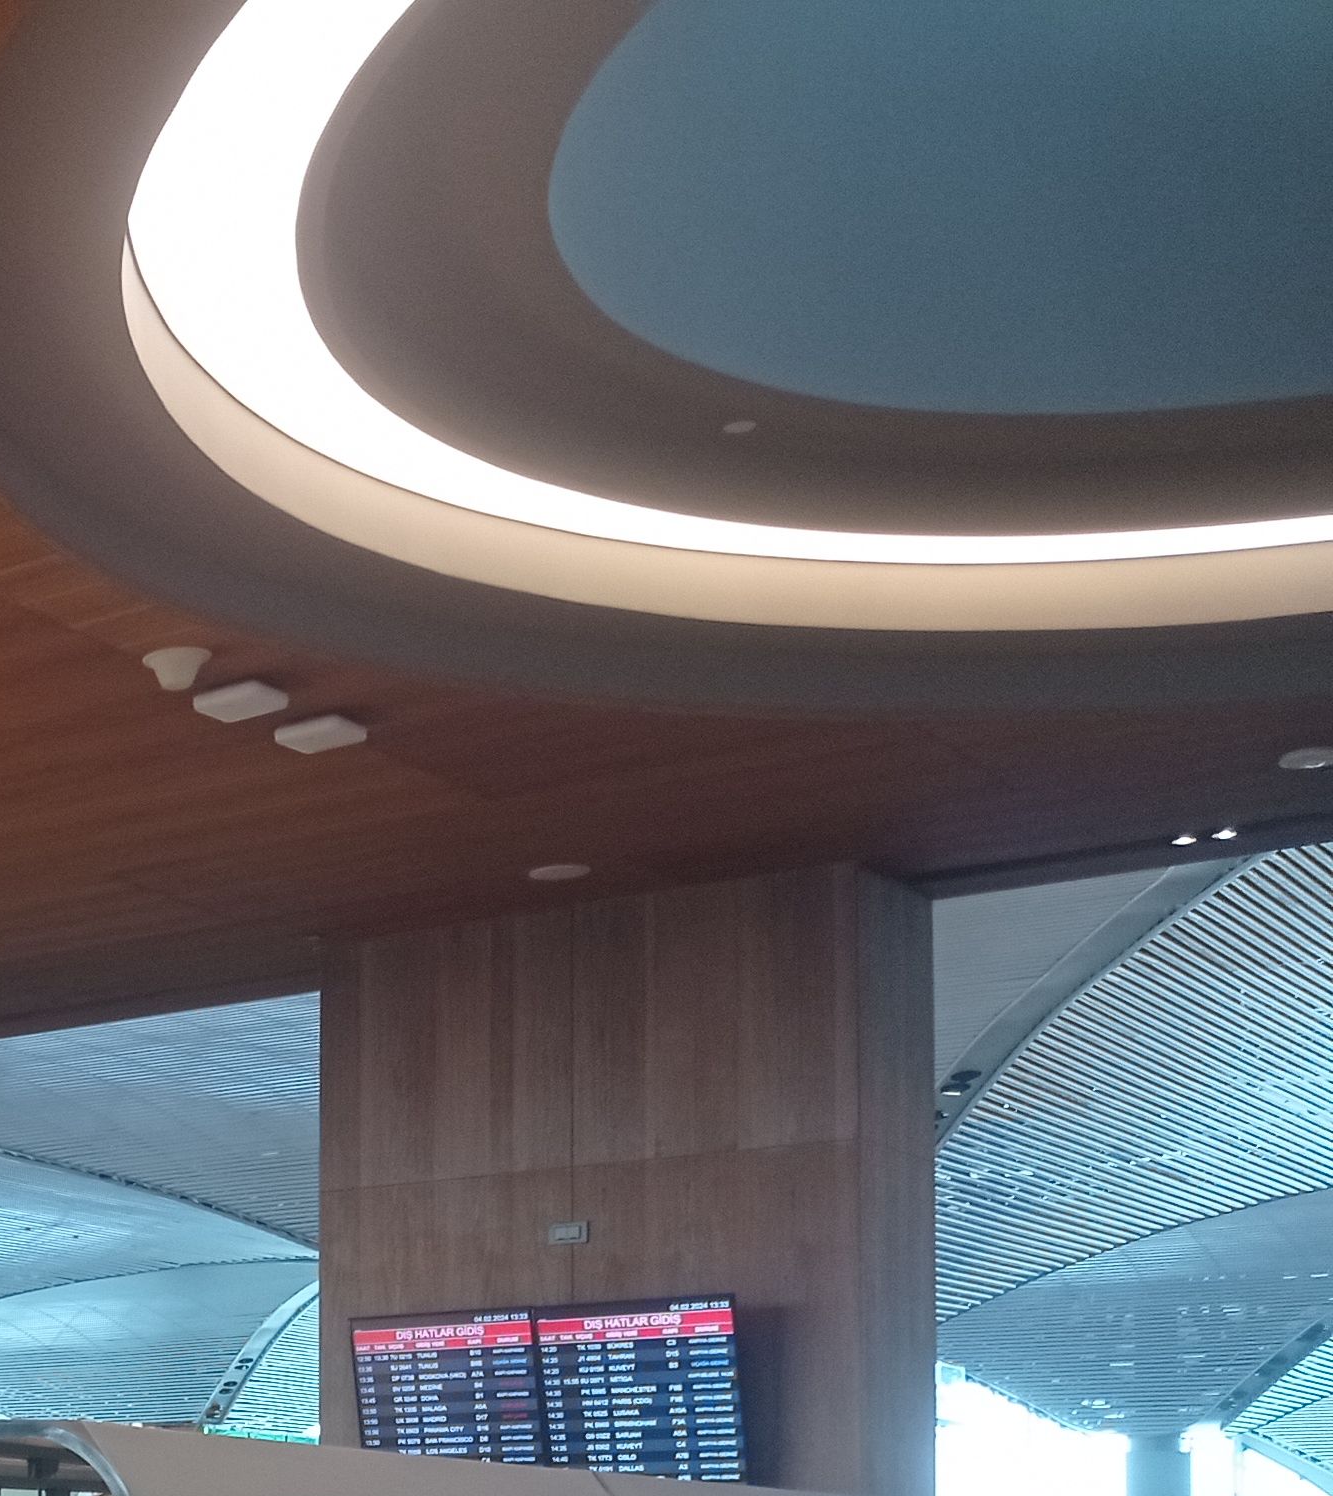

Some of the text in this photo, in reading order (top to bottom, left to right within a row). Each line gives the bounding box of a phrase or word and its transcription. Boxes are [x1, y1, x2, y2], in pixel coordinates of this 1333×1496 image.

[583, 1313, 681, 1331] DIŞ HATLAR GİDİŞ
[395, 1325, 485, 1341] DIŞ HATLAR GİDİŞ
